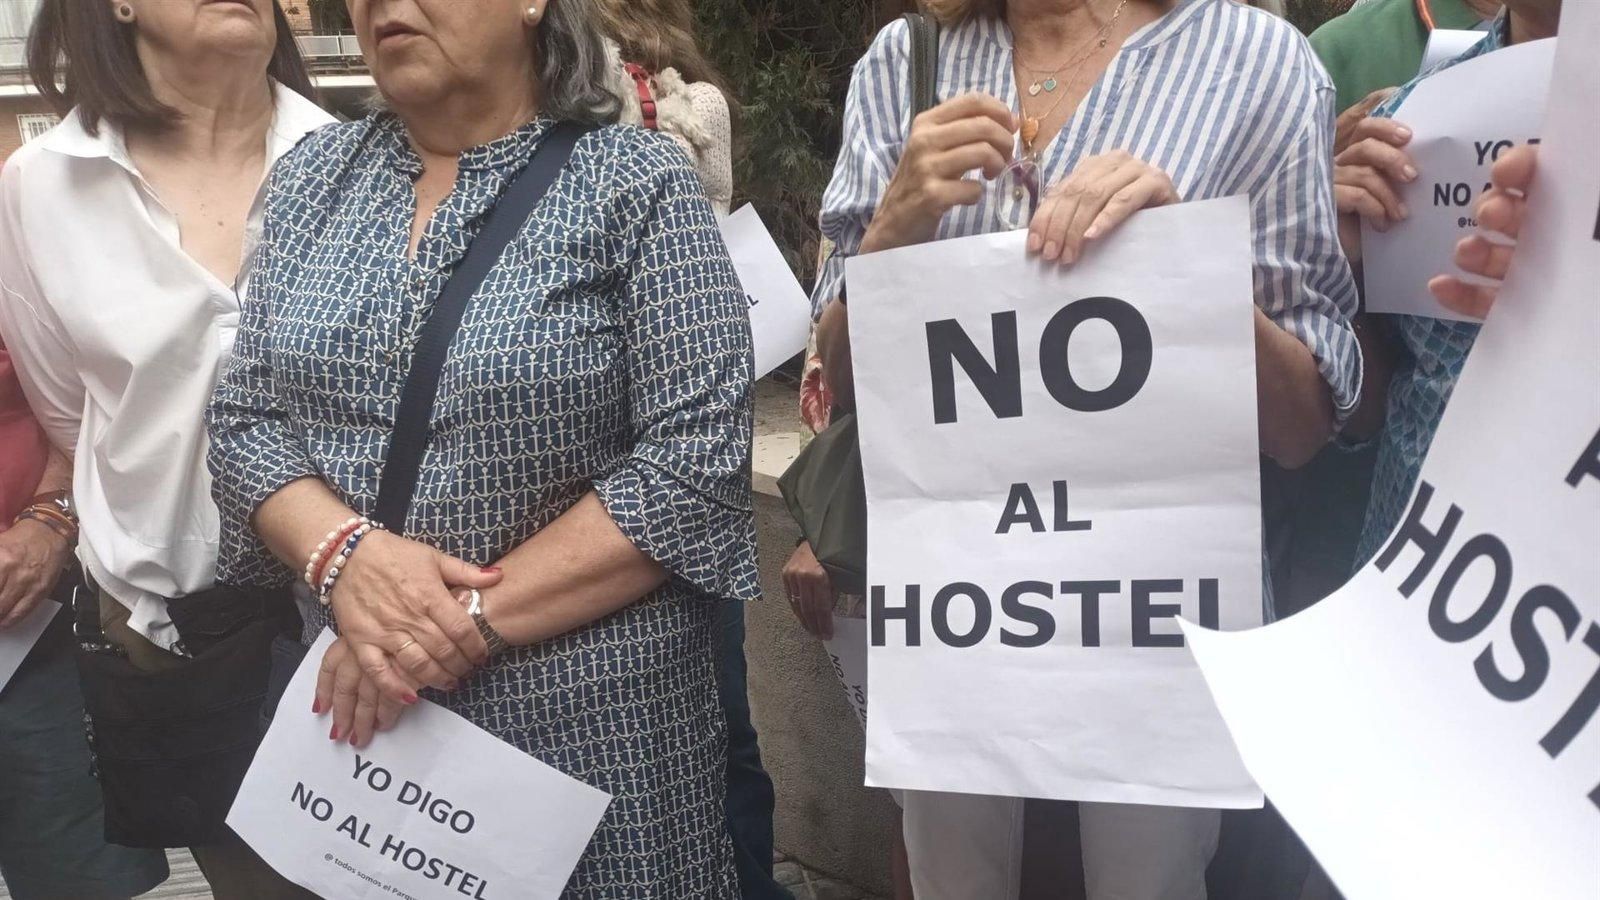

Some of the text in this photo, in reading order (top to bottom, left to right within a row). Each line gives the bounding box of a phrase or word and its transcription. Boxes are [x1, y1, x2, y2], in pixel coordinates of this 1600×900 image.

[1434, 182, 1471, 207] NO
[925, 296, 1153, 424] NO
[995, 480, 1092, 534] AL
[353, 754, 475, 834] YO DIGO
[291, 781, 487, 900] NO AL HOSTEL
[335, 858, 356, 874] todos
[357, 871, 382, 887] somos
